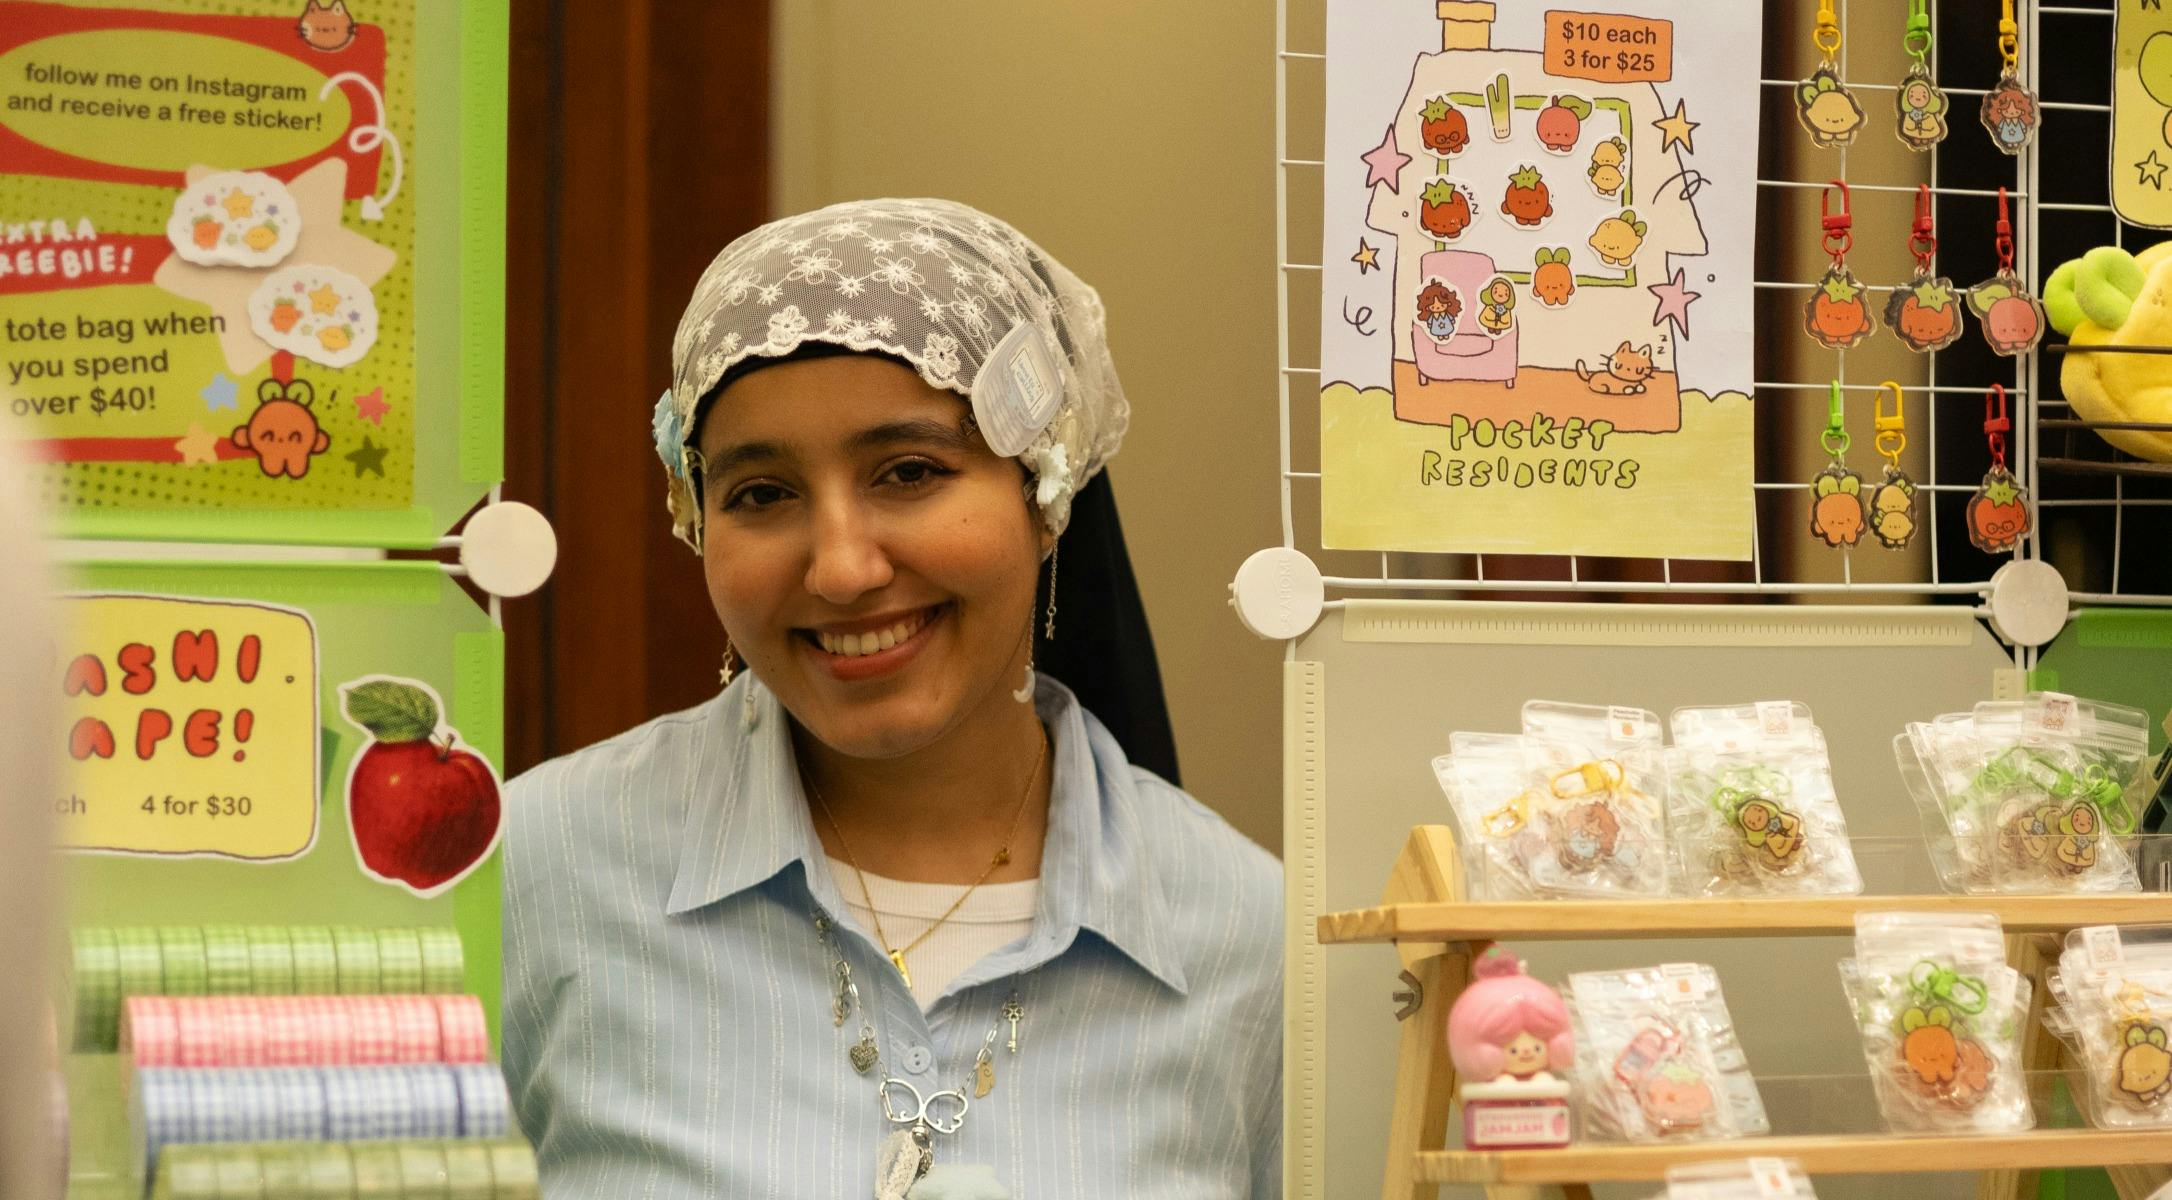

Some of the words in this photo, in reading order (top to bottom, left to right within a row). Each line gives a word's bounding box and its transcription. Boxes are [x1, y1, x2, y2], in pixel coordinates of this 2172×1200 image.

[1562, 19, 1600, 44] $10
[1606, 26, 1657, 45] each
[1563, 49, 1576, 67] 3
[1581, 50, 1611, 69] for
[1617, 50, 1655, 74] $25
[25, 63, 98, 88] follow
[106, 72, 142, 89] me
[149, 76, 179, 93] on
[187, 75, 307, 104] Instagram
[7, 94, 53, 113] and
[60, 97, 151, 120] receive
[158, 106, 172, 121] a
[178, 102, 227, 125] free
[233, 109, 323, 132] sticker!
[0, 217, 97, 245] XTRA
[0, 245, 134, 278] REEBIE!
[6, 317, 67, 342] tote
[77, 315, 134, 343] bag
[144, 311, 227, 337] when
[8, 359, 64, 386] you
[74, 349, 169, 381] spend
[11, 396, 81, 417] over
[90, 386, 157, 416] $40!
[1450, 412, 1615, 451] POCKET
[1421, 450, 1641, 488] RESIDENTS
[64, 629, 262, 697] ASHI
[69, 708, 255, 762] APE!
[140, 796, 156, 815] 4
[163, 795, 200, 815] for
[206, 795, 253, 819] $30
